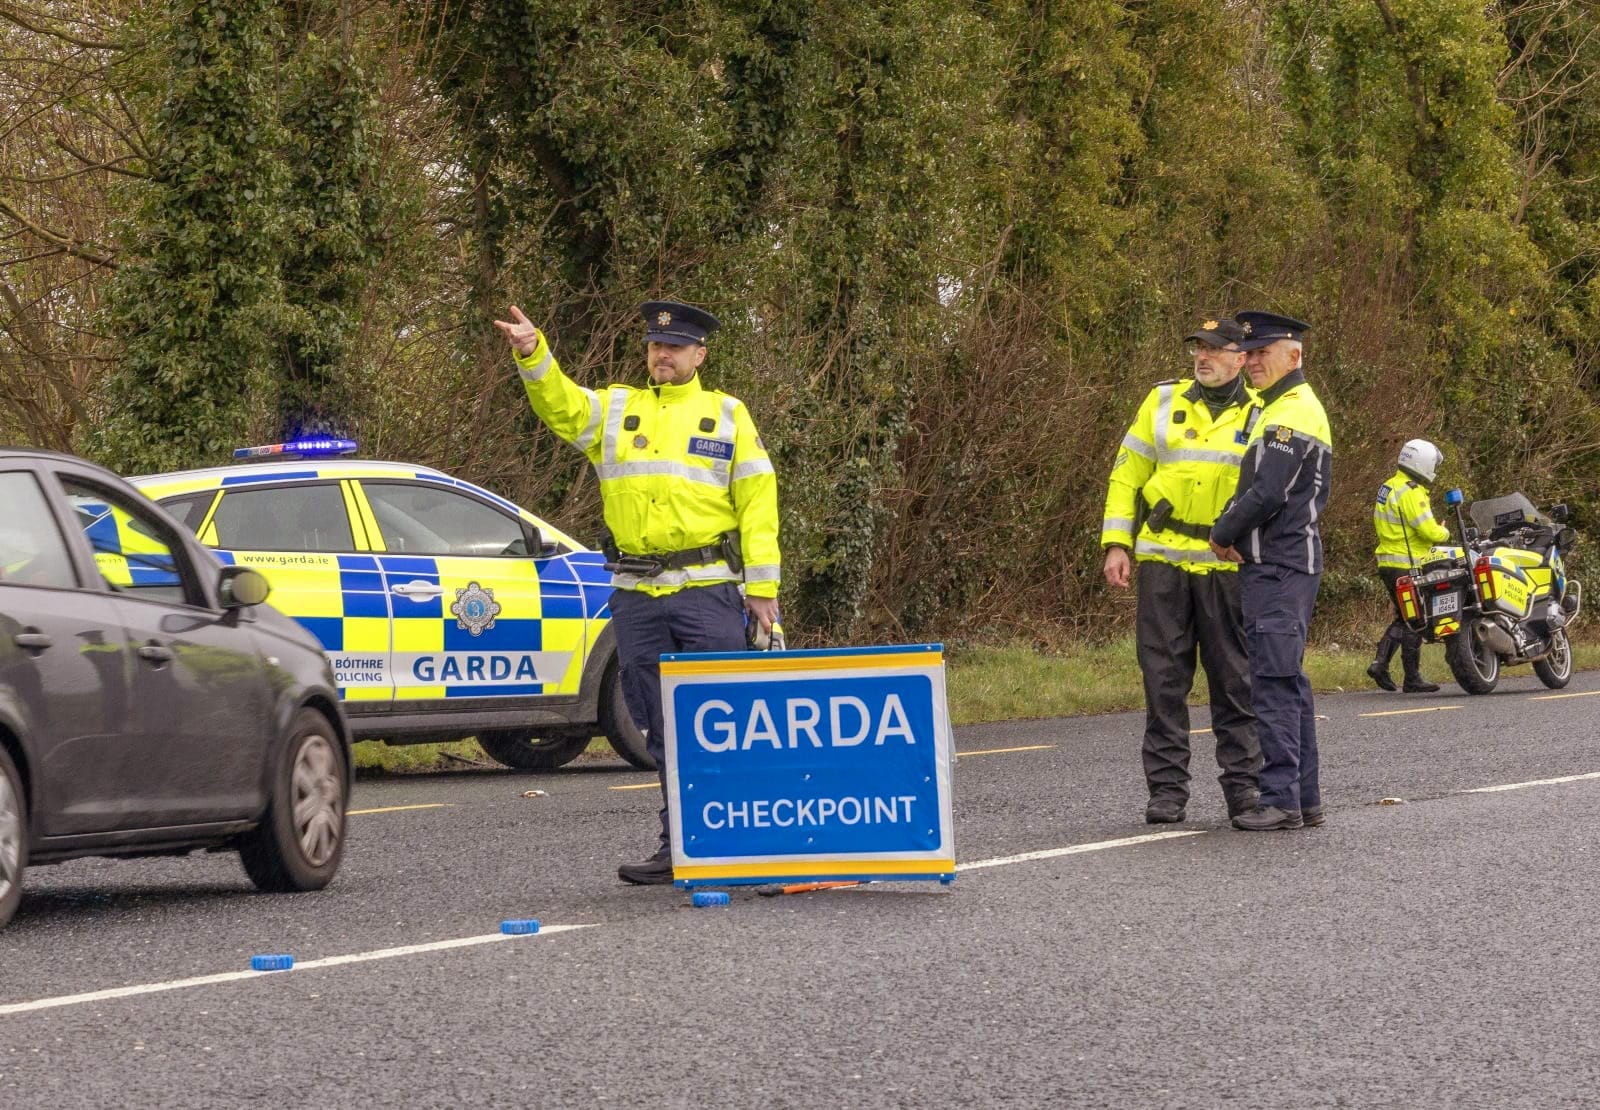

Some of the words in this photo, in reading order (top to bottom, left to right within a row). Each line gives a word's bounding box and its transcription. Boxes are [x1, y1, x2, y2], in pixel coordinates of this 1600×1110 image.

[696, 440, 726, 454] GARDA
[243, 554, 329, 565] www.garda.ie
[335, 657, 384, 669] BÓITHRE
[412, 655, 538, 682] GARDA
[335, 672, 383, 682] OLICING
[693, 693, 916, 753] GARDA
[702, 795, 917, 829] CHECKPOINT
